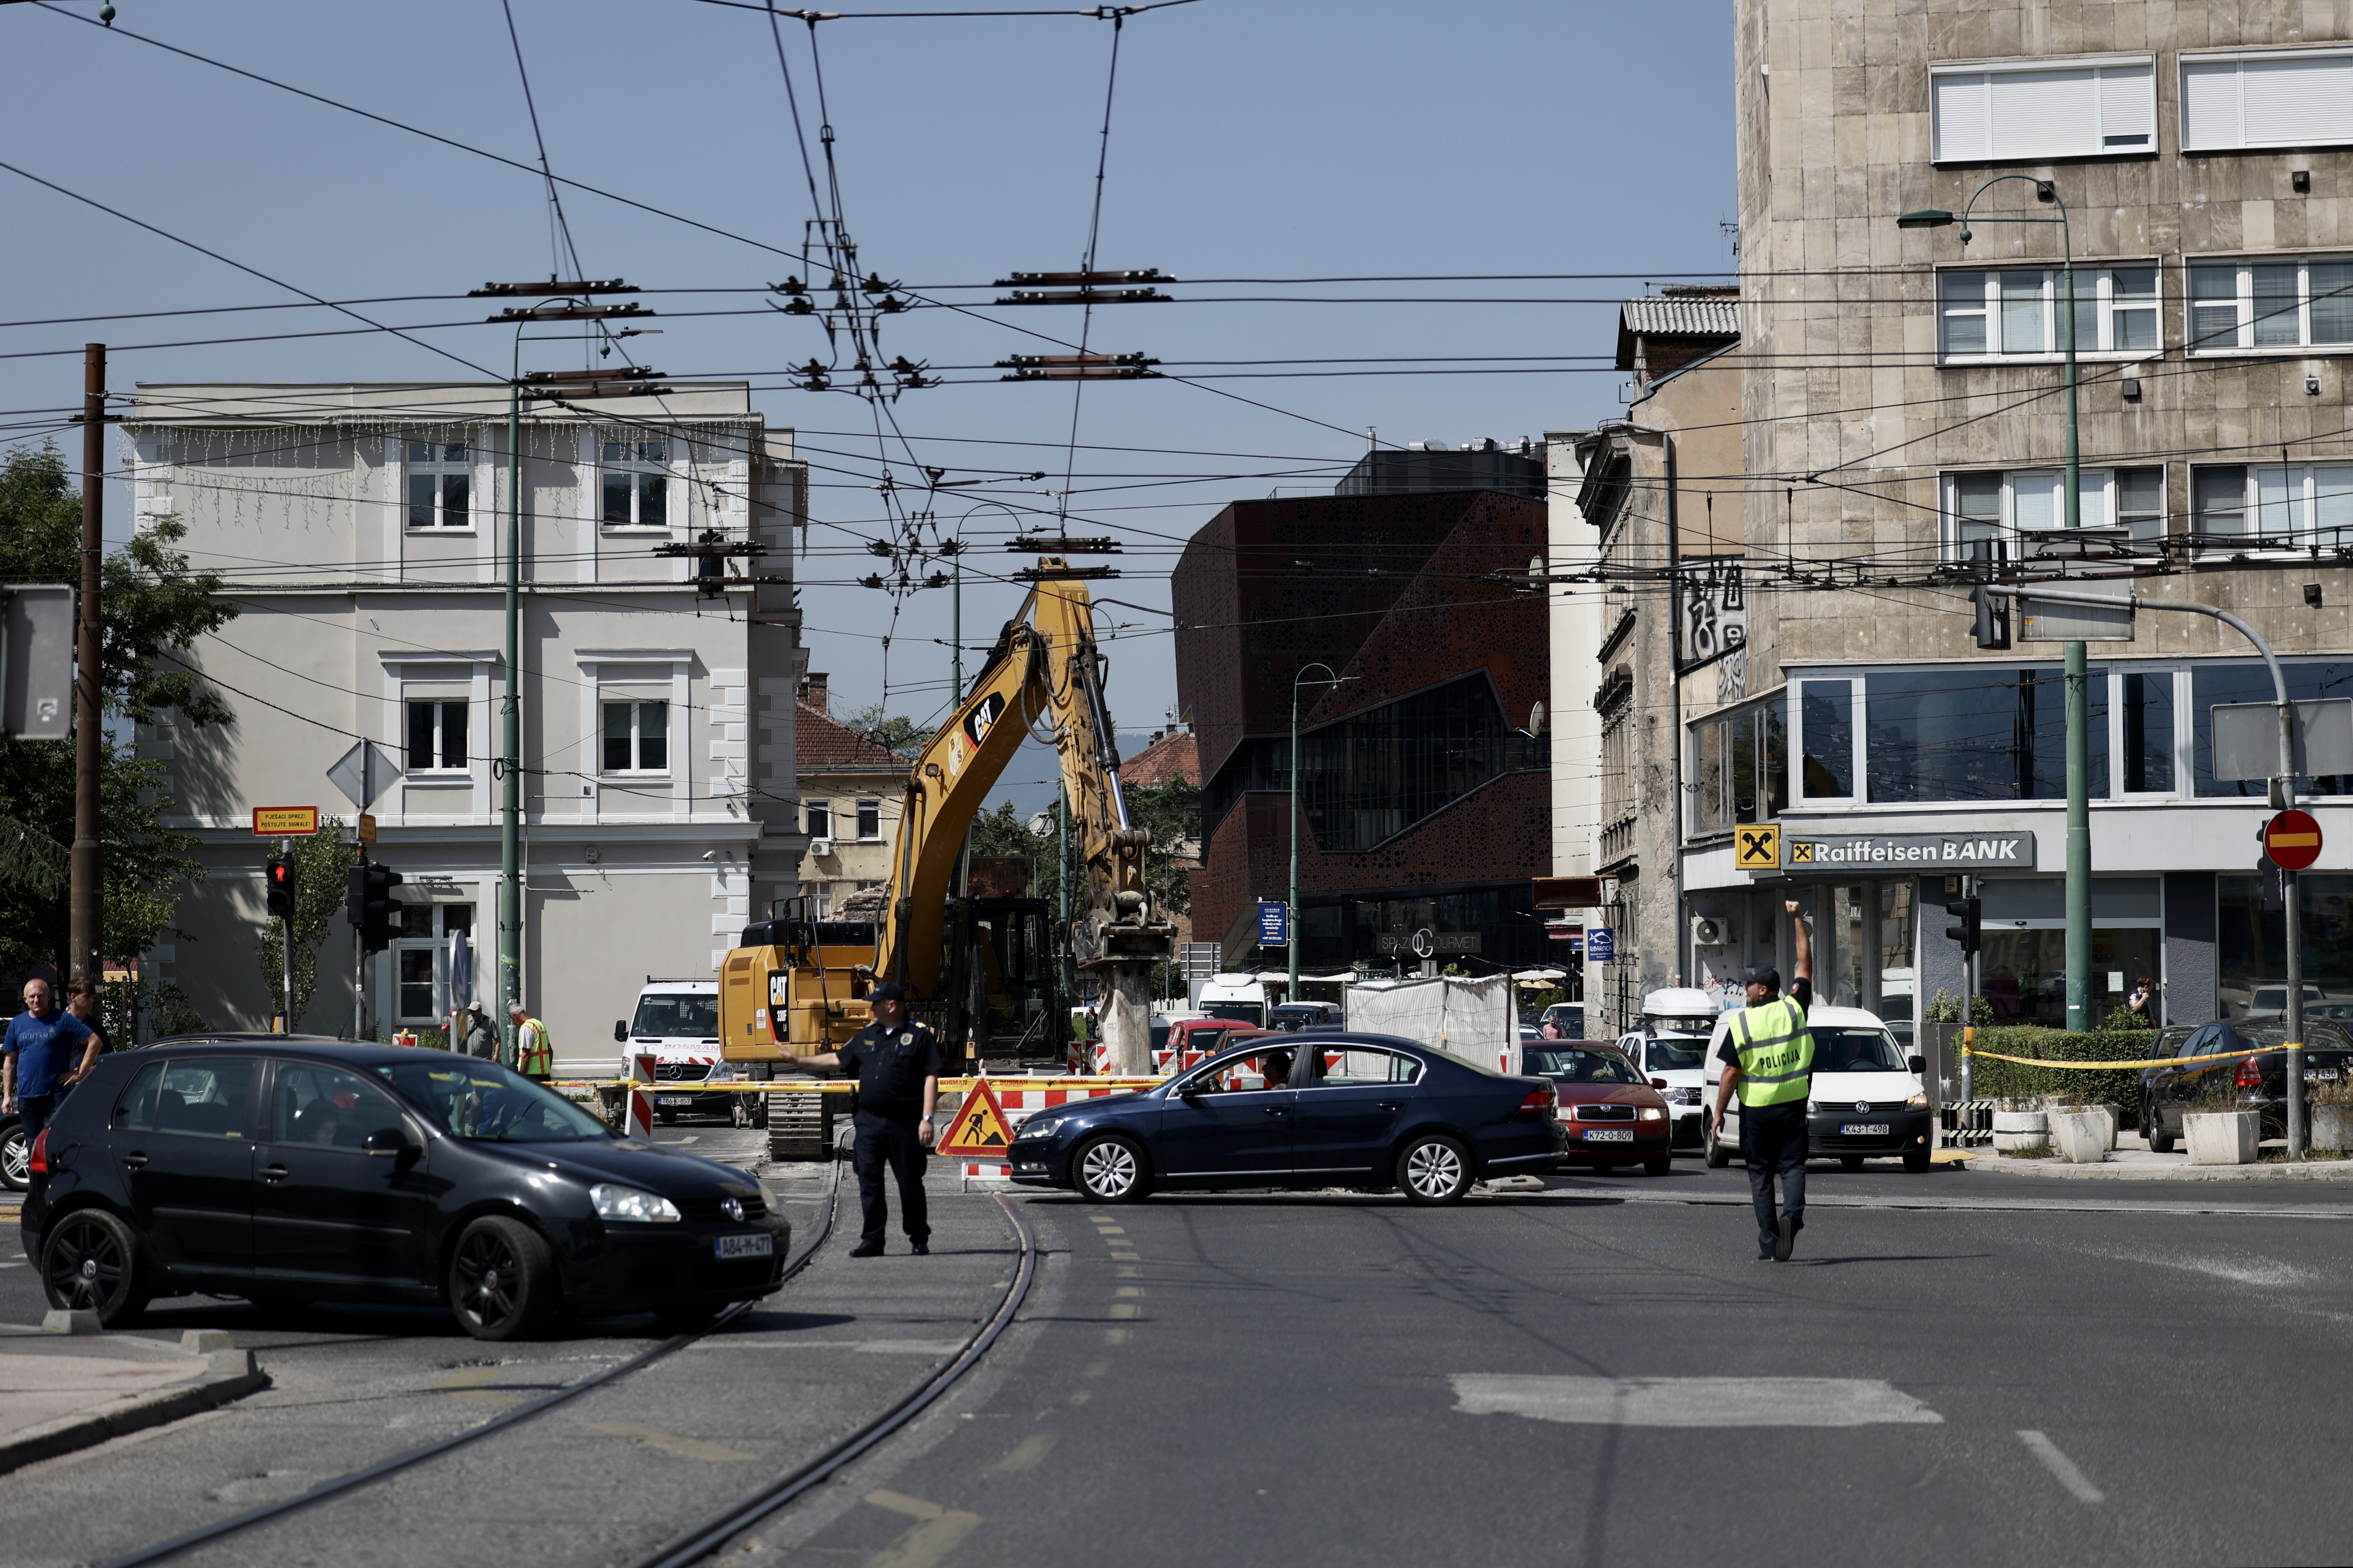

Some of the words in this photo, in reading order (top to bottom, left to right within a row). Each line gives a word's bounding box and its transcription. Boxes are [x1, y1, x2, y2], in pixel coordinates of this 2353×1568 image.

[974, 698, 992, 742] CAT
[1815, 840, 1936, 862] Raiffeisen
[1941, 840, 2020, 860] BANK
[1417, 928, 1476, 958] GOURMET
[770, 976, 787, 1005] CAT
[777, 1009, 787, 1022] 330F
[1760, 1049, 1800, 1069] POLICIJA
[2304, 1070, 2336, 1078] 4-J-436
[1589, 1131, 1631, 1140] K72-O-809
[1846, 1125, 1887, 1133] K43-T-498
